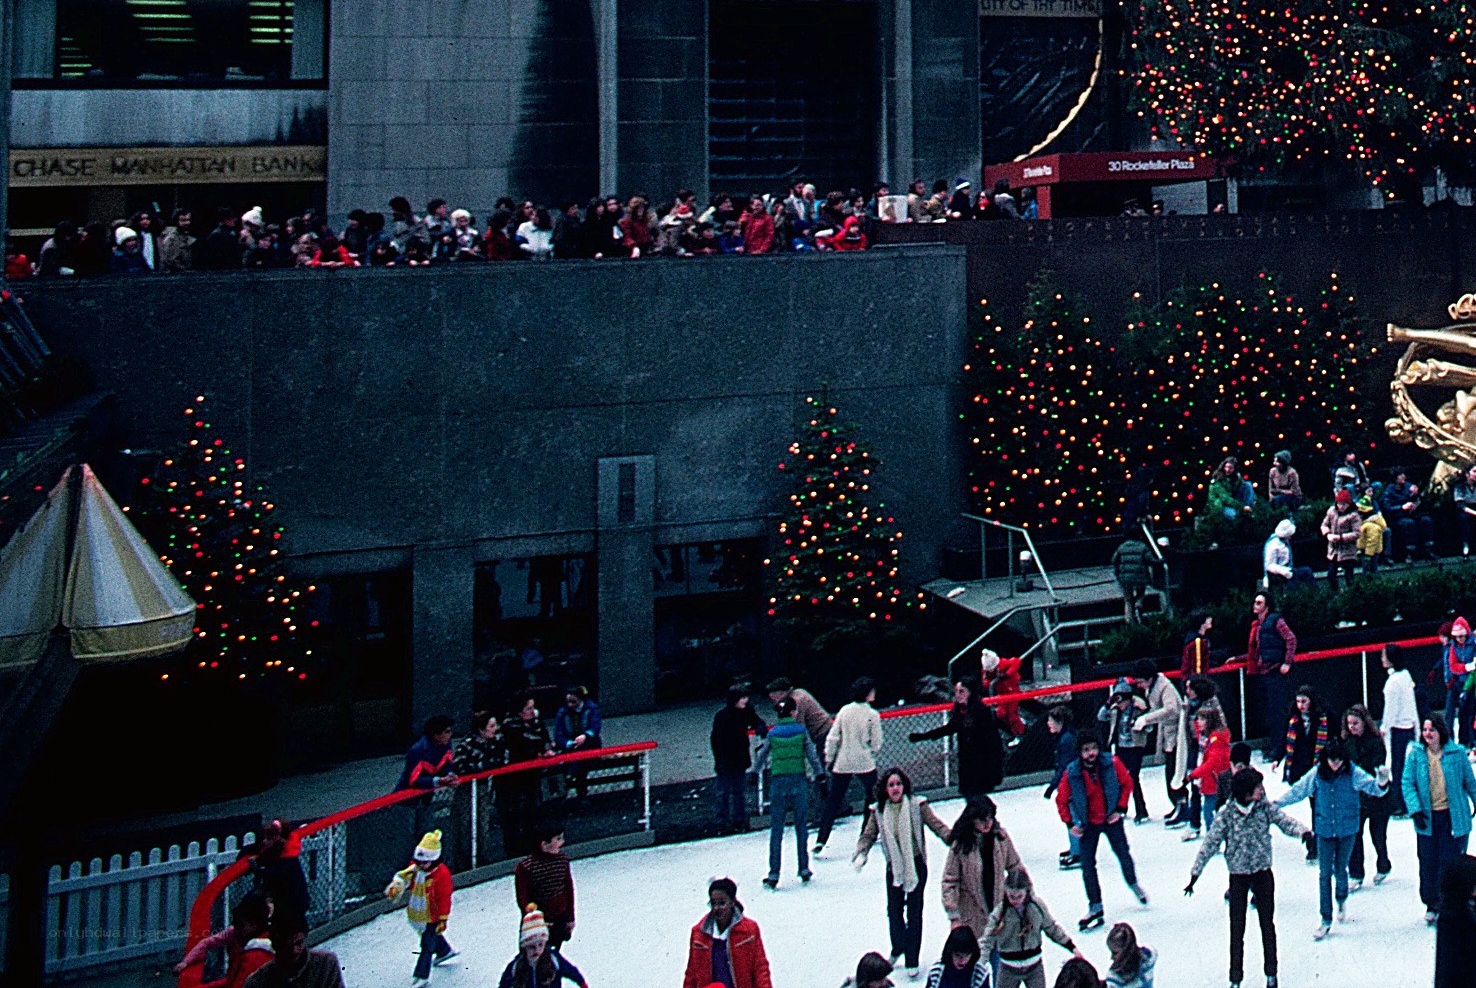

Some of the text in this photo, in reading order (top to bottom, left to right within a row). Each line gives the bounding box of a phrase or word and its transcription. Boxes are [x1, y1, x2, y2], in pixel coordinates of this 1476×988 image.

[13, 154, 317, 177] CHASE MANHATTAN BANK
[1108, 159, 1195, 171] 30 Rockefeller Plaza
